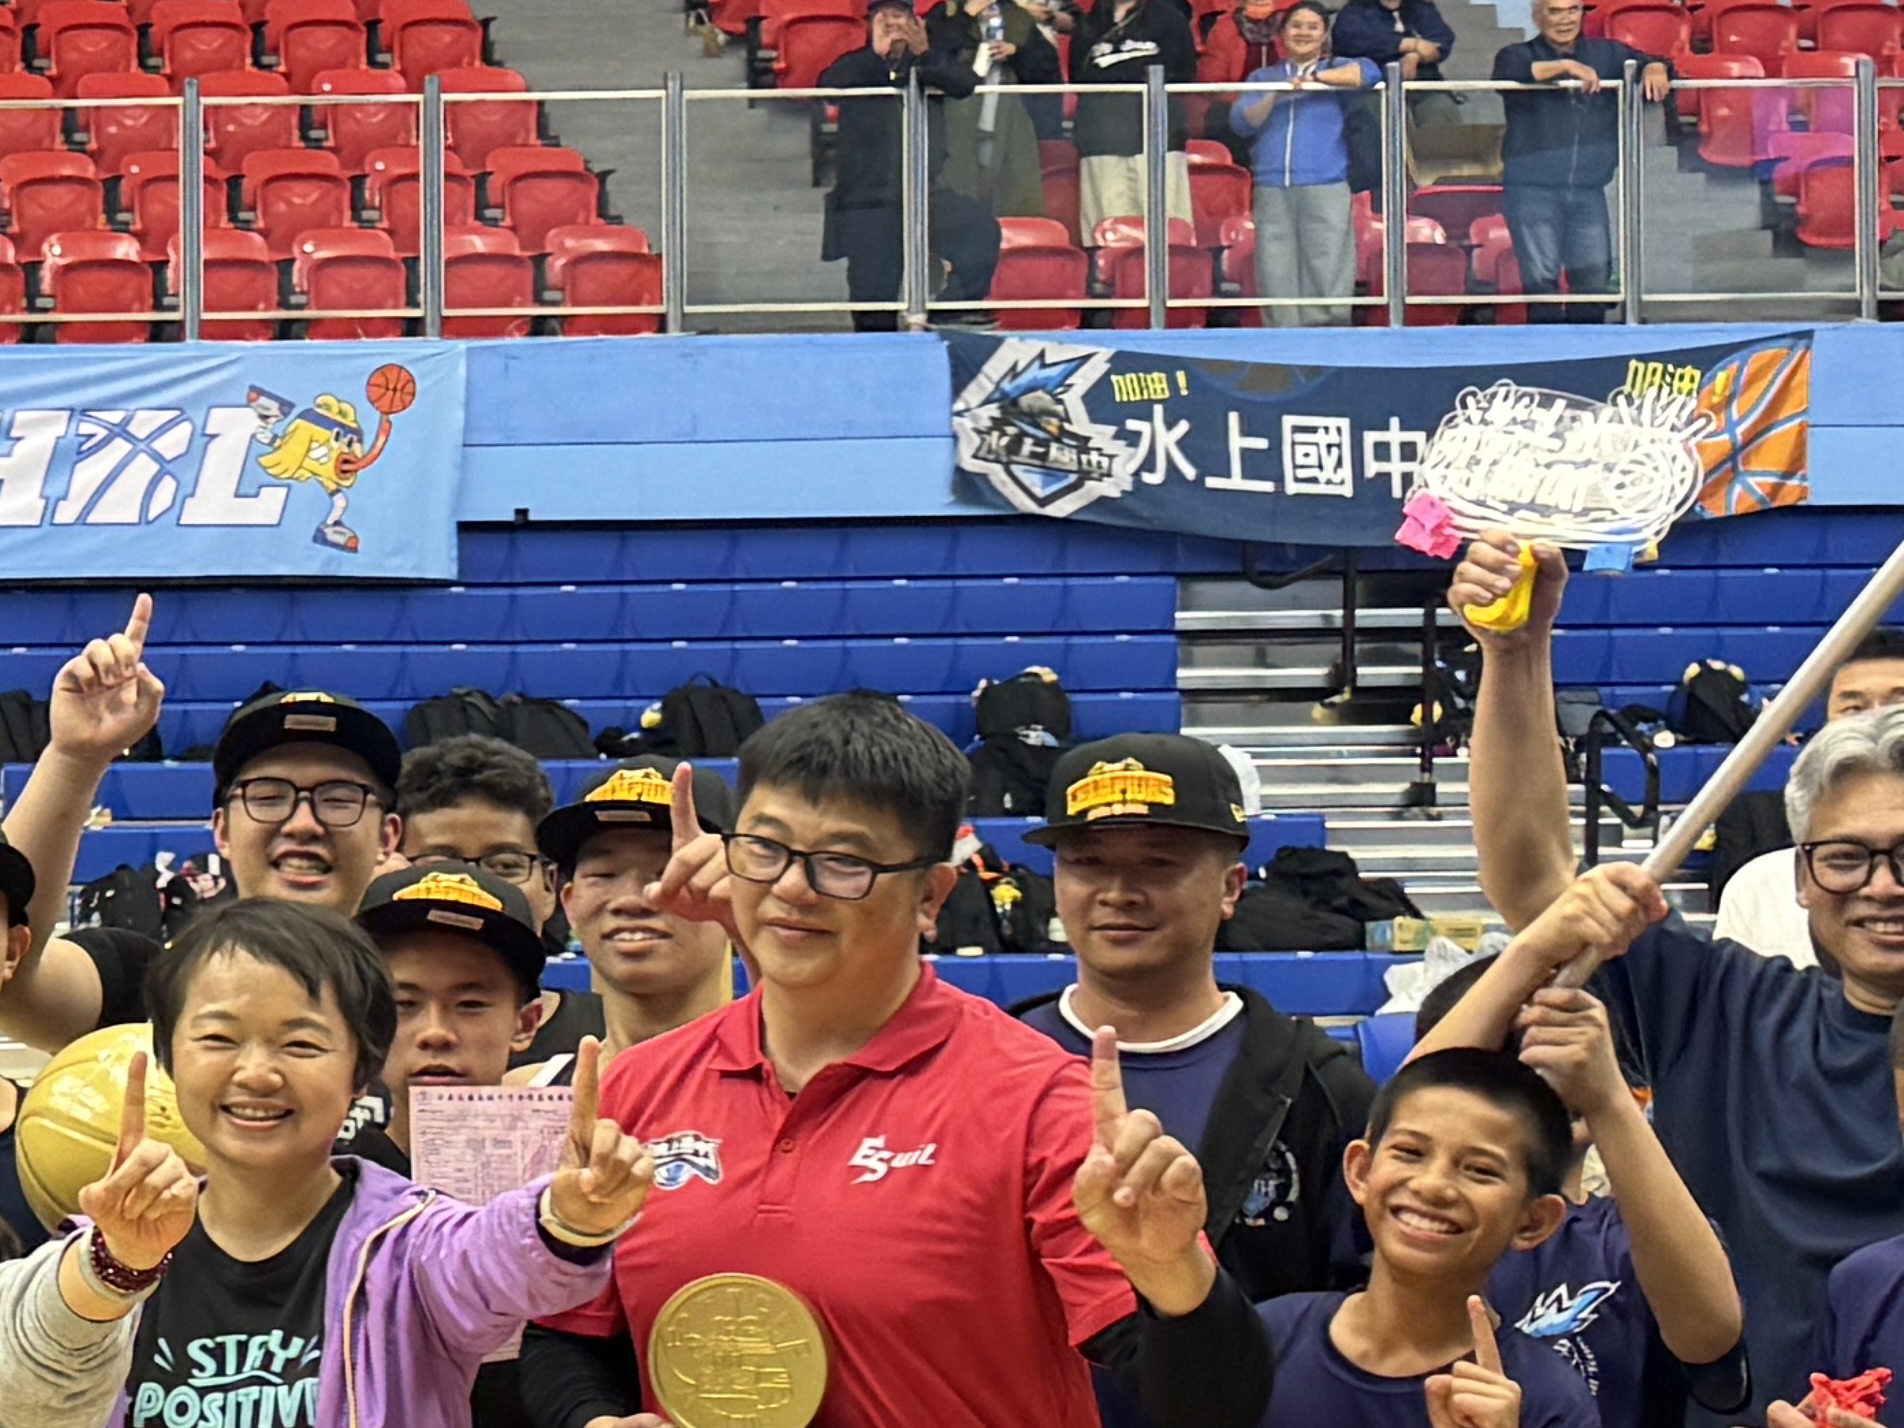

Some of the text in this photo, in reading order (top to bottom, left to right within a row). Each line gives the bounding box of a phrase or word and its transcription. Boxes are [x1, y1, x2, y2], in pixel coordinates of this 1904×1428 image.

[1122, 403, 1428, 499] 水上國中
[186, 1329, 305, 1378] STAY
